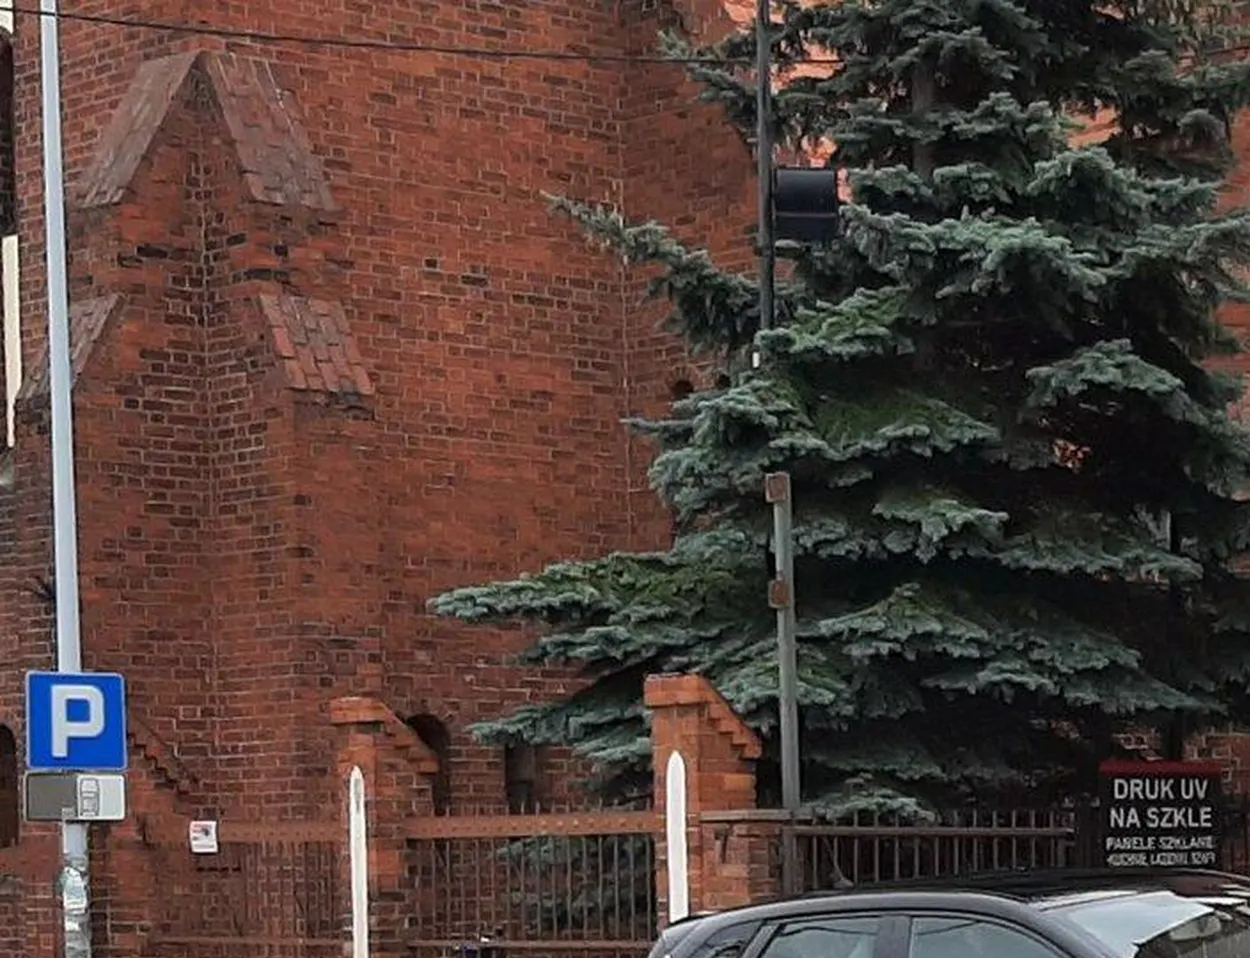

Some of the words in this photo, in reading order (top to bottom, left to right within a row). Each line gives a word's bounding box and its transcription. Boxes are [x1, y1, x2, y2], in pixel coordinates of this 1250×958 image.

[51, 684, 104, 758] P
[1113, 778, 1174, 800] DRUK
[1180, 778, 1208, 800] UV
[1109, 806, 1141, 828] NA
[1146, 806, 1213, 828] SZKLE
